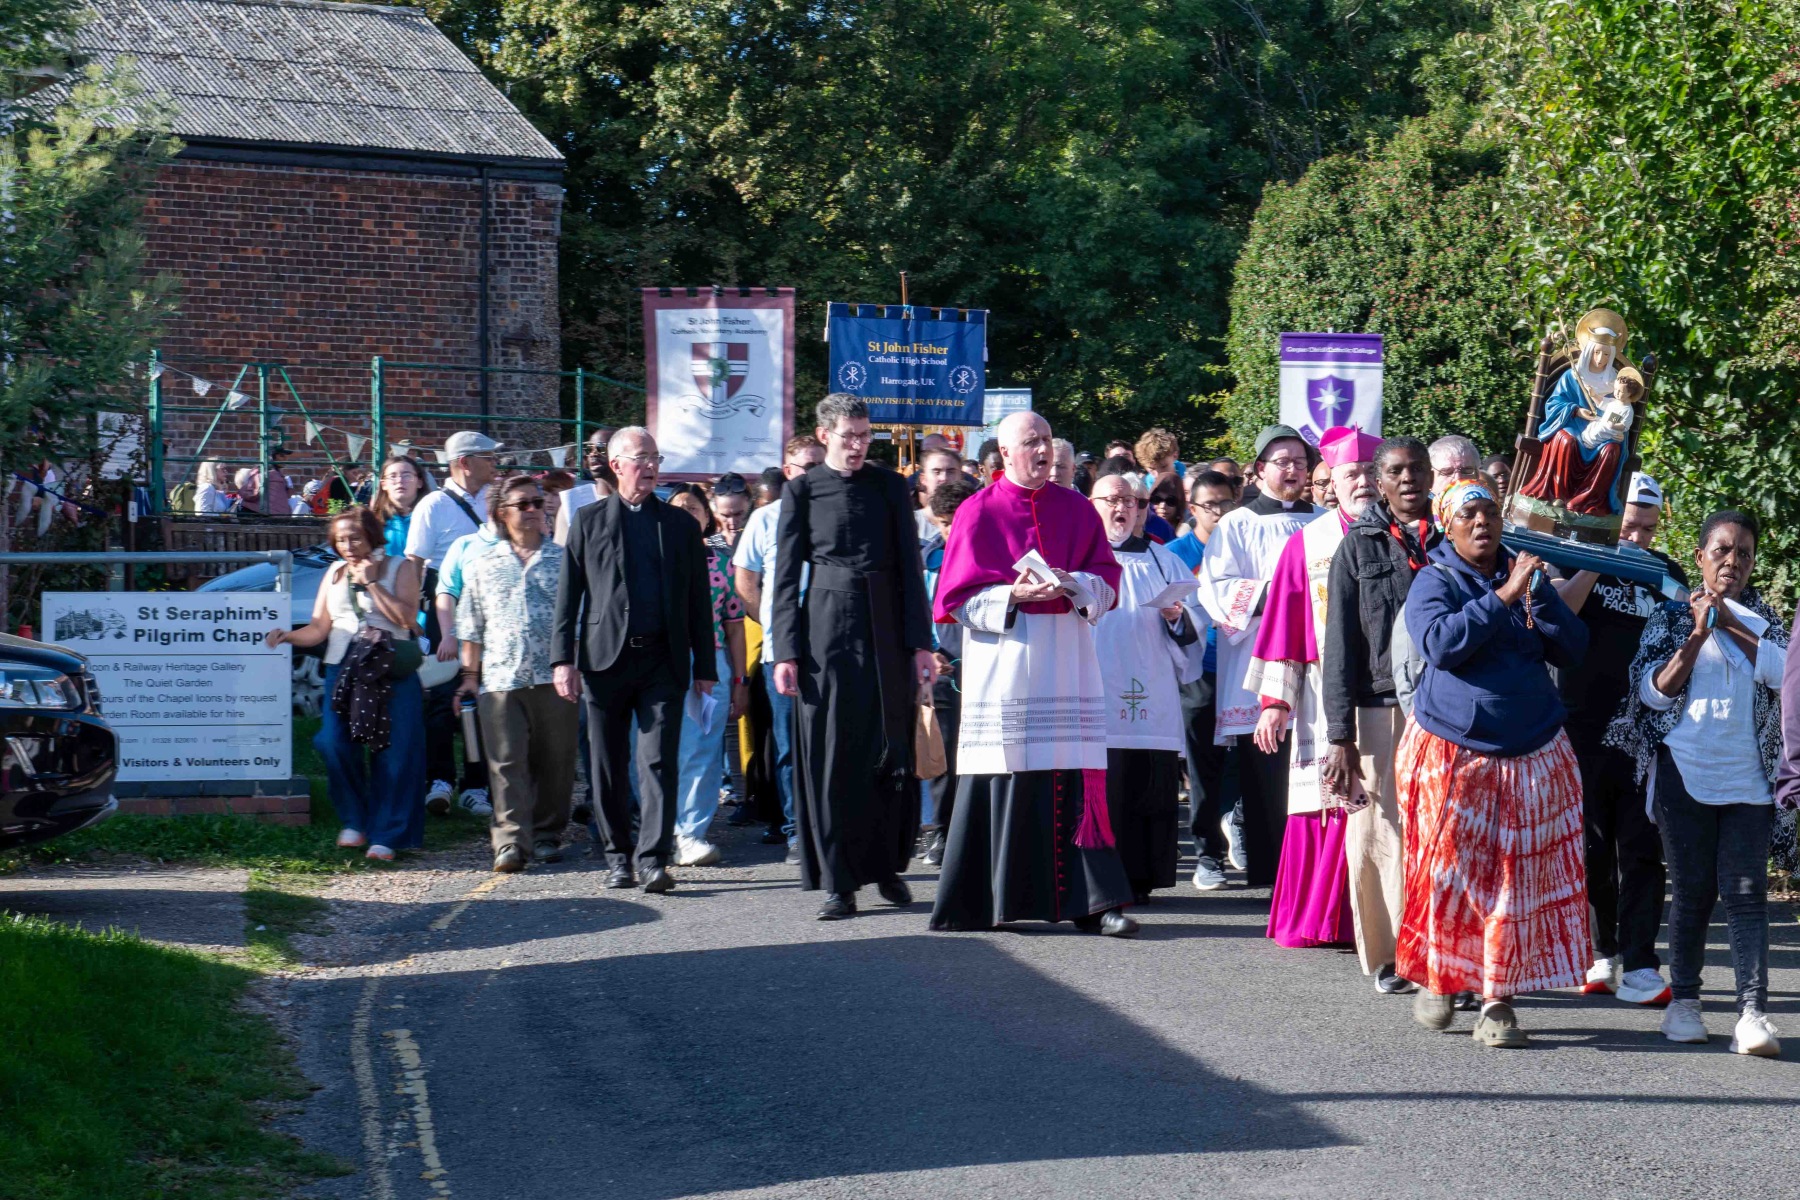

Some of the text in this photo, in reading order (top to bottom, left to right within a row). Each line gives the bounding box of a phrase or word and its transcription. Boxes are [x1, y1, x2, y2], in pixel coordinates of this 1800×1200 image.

[868, 341, 949, 354] St John Fisher
[868, 355, 948, 366] Catholic High School
[921, 378, 936, 386] UK
[915, 398, 936, 406] PRAY
[1602, 597, 1636, 616] FACE
[138, 606, 159, 620] St
[134, 628, 269, 646] Pilgrim Chap
[113, 662, 120, 672] &
[123, 662, 163, 674] Railway
[166, 662, 208, 674] Heritage
[210, 662, 246, 674] Gallery
[124, 678, 213, 688] The Quiet Garden
[101, 694, 278, 705] ours of the Chapel Icons by request
[130, 710, 160, 719] Room
[163, 709, 207, 718] available
[210, 709, 224, 718] for
[226, 709, 244, 718] hire
[122, 757, 280, 768] Visitors & Volunteers Only
